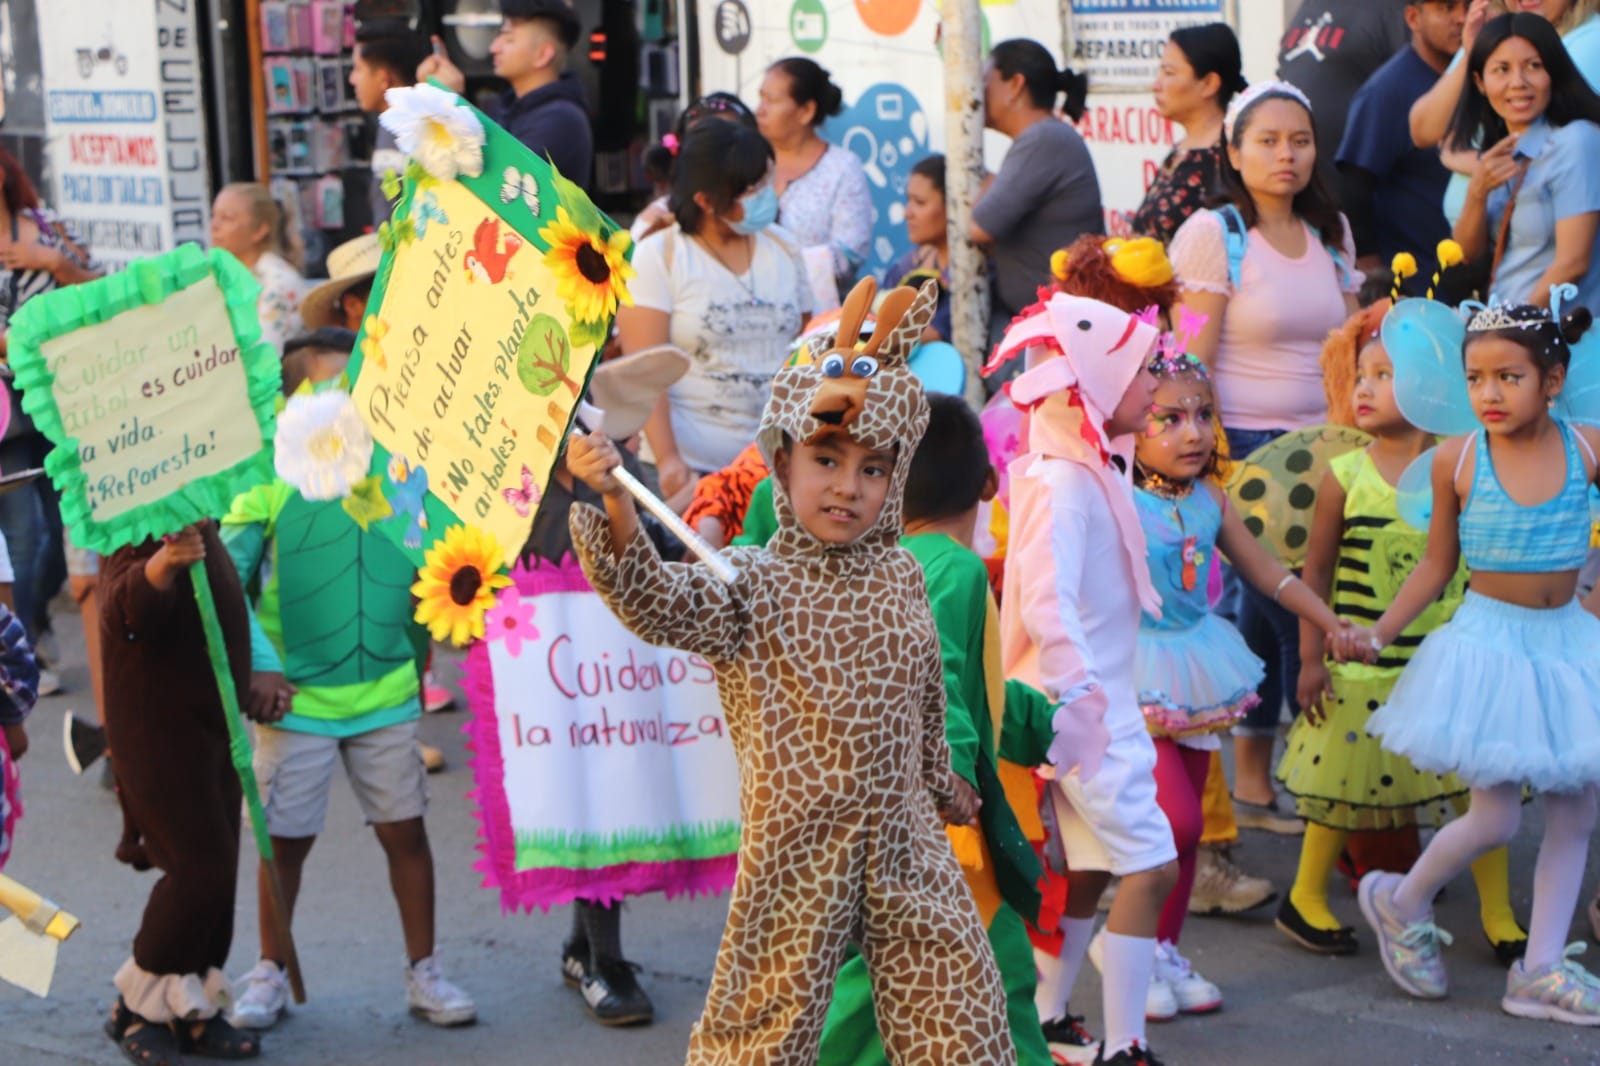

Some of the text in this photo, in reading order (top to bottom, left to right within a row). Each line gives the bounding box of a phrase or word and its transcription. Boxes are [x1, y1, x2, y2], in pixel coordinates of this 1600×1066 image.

[159, 27, 188, 48] DE
[1074, 39, 1166, 60] REPARACIO
[53, 324, 199, 395] Cuidar un
[369, 229, 464, 434] Piensa antes
[140, 377, 166, 399] es
[172, 343, 239, 387] cuidar
[412, 320, 473, 462] de actuar
[512, 712, 552, 748] la
